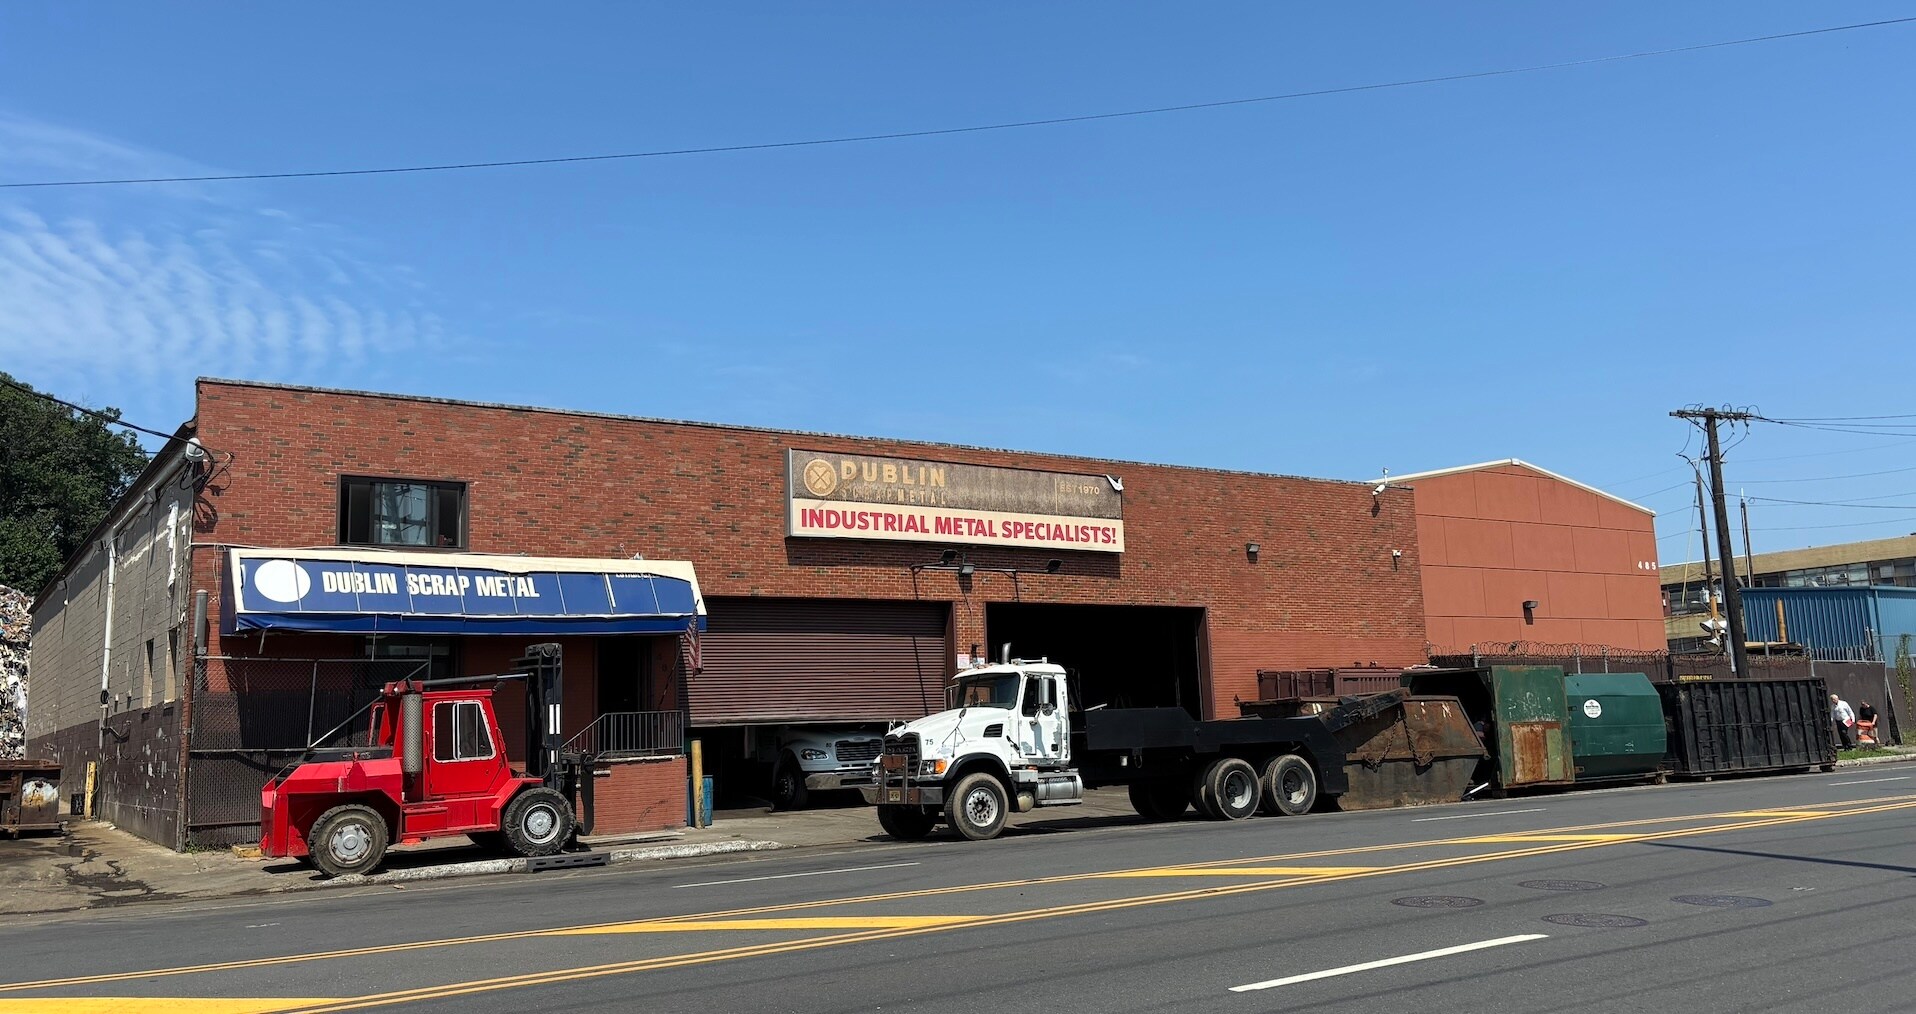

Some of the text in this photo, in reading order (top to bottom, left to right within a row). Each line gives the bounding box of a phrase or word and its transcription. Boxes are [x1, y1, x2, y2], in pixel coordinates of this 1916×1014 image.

[841, 460, 945, 487] DUBLIN
[897, 488, 946, 505] METAL
[1078, 484, 1100, 495] 1970
[801, 508, 1117, 544] INDUSTRIAL METAL SPECIALISTS!
[1637, 560, 1657, 570] 485
[321, 571, 541, 598] DUBLIN SCRAP METAL
